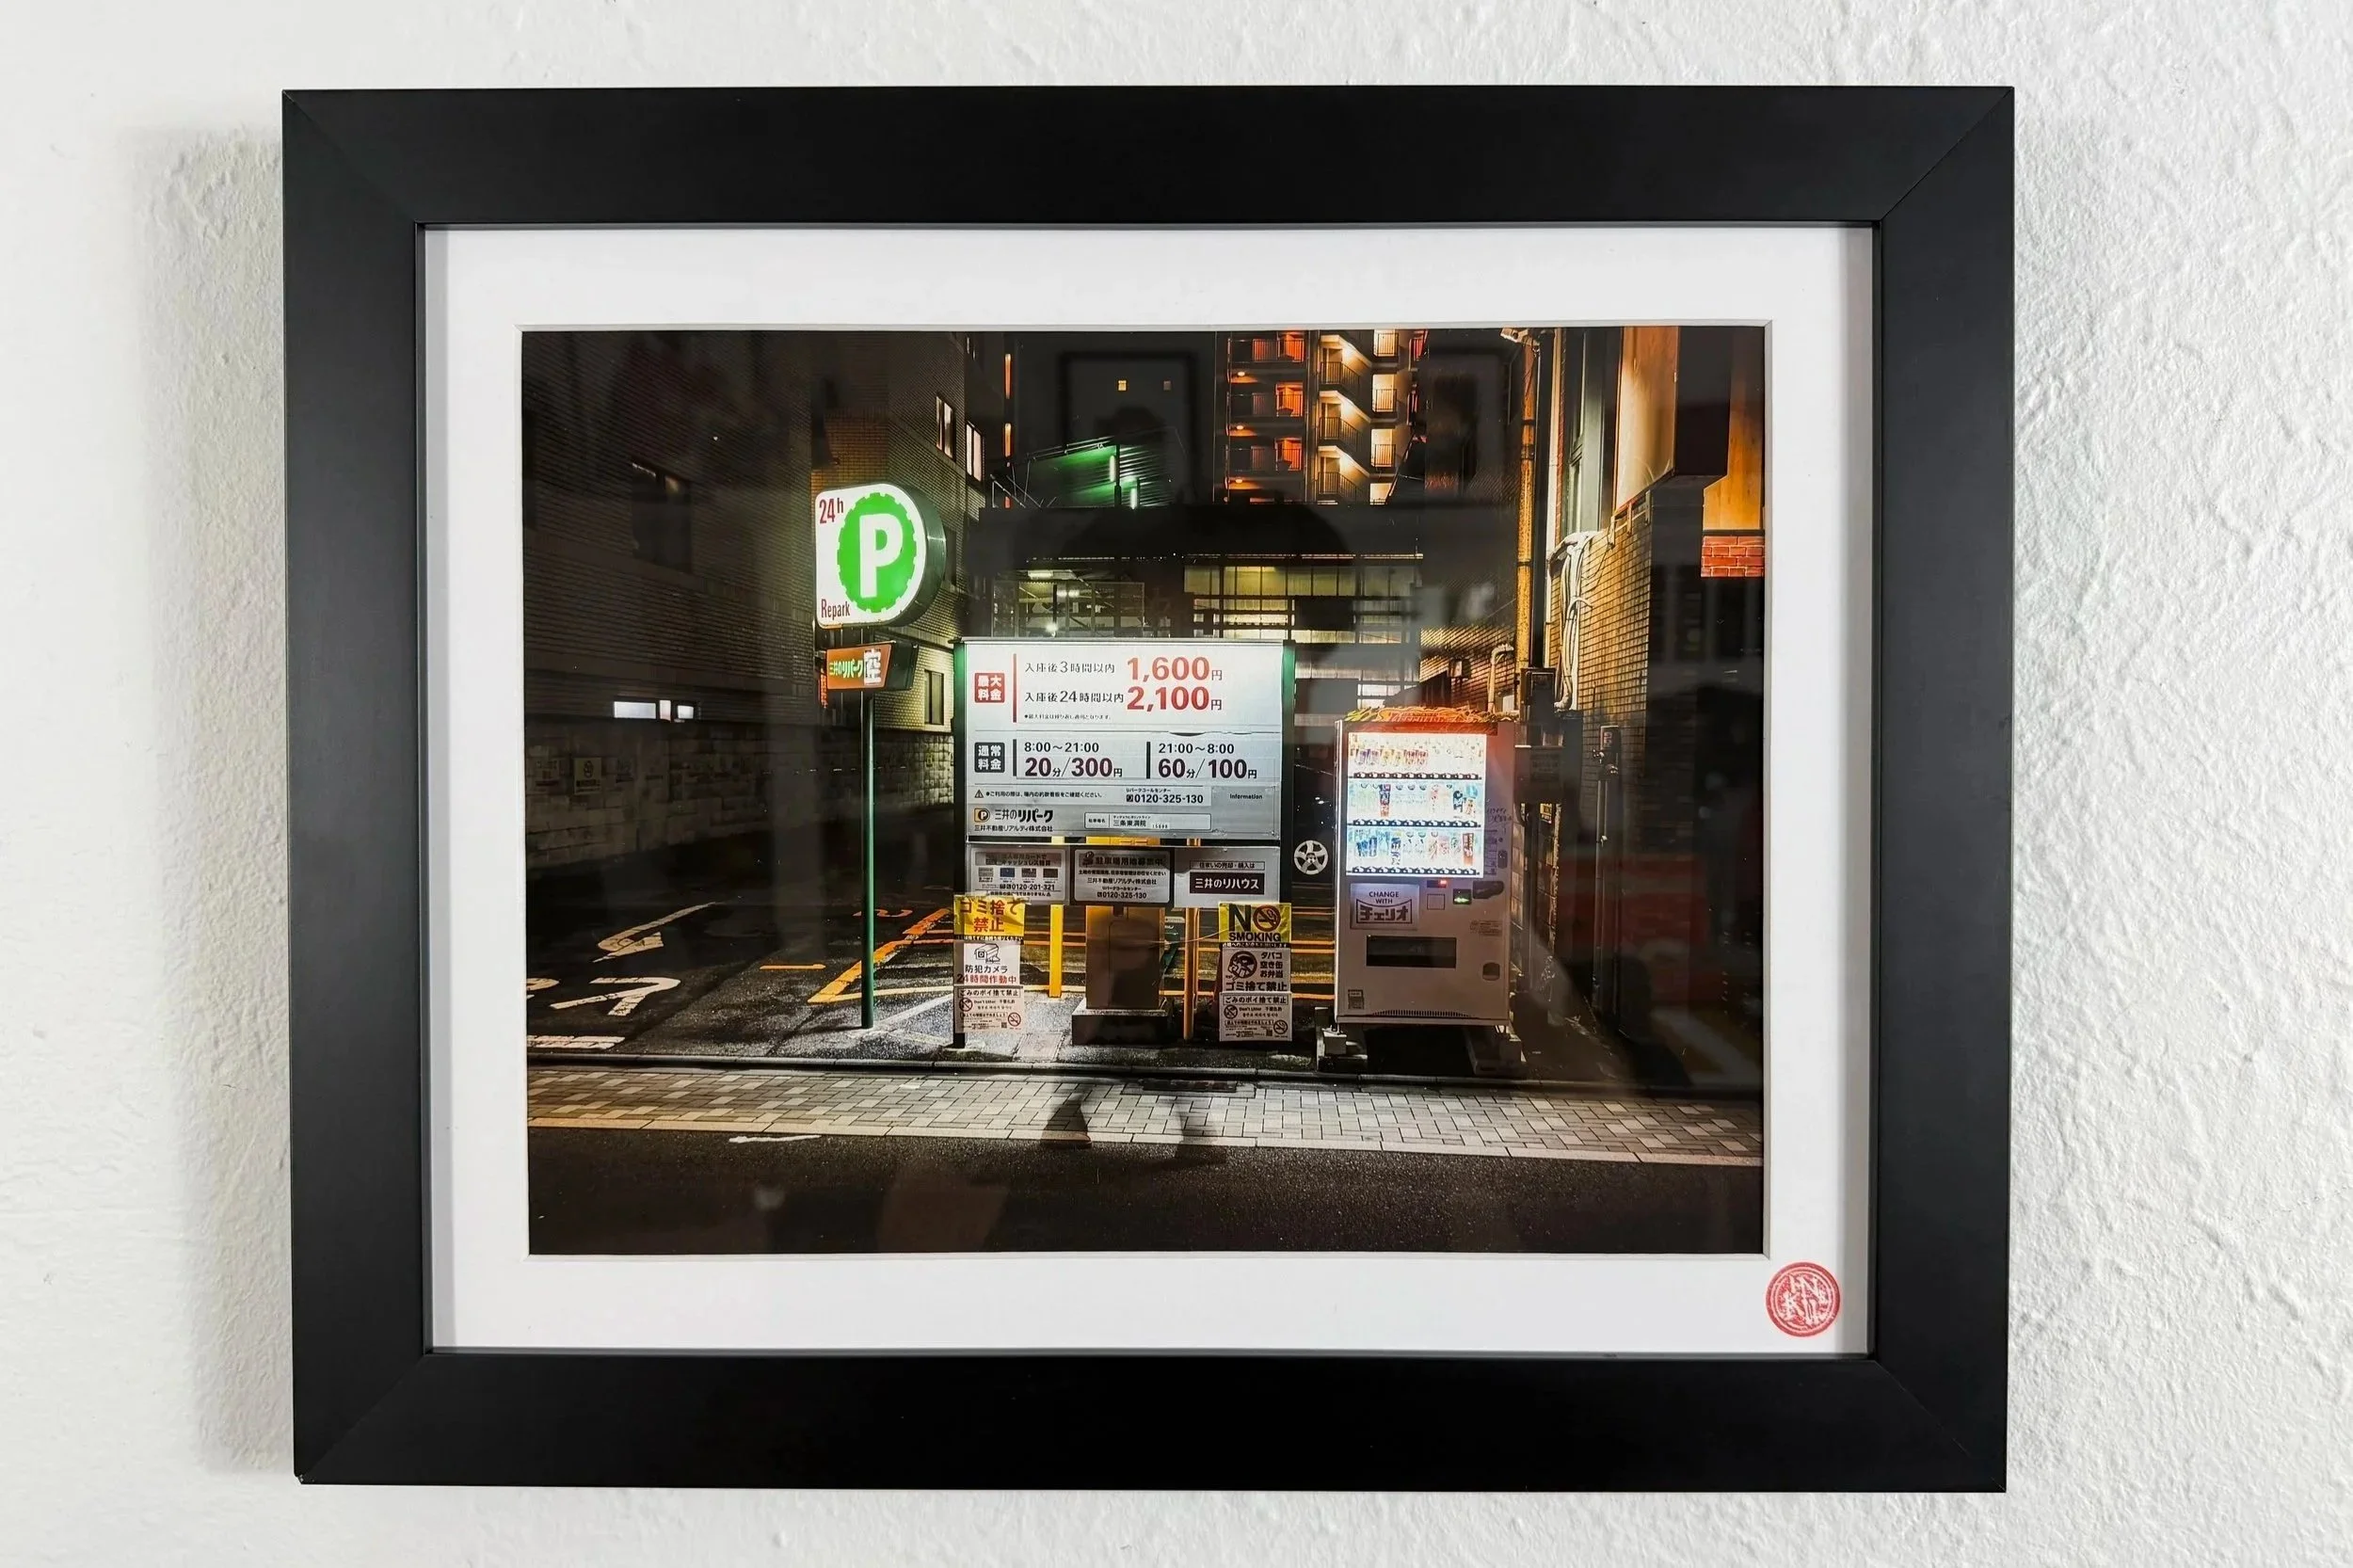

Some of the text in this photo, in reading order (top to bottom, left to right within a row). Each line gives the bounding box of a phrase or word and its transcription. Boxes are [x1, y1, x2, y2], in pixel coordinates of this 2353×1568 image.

[859, 513, 904, 599] P
[821, 599, 850, 620] Repark
[829, 659, 863, 679] 三井のリパーク
[978, 688, 1001, 700] 料金
[978, 744, 1001, 757] 通常
[978, 758, 1001, 770] 料金
[1134, 794, 1204, 804] 0120-325-130
[995, 808, 1053, 823] 三井のリパーク
[1194, 878, 1259, 889] 三井のリハウス
[960, 899, 1019, 916] ゴミ捨て
[1360, 905, 1409, 921] チェリオ
[973, 917, 1005, 933] 禁止
[1229, 932, 1281, 941] SMOKING
[1260, 952, 1282, 960] タバコ
[965, 964, 1008, 973] 防犯カメラ
[1260, 960, 1283, 969] 空き缶
[957, 973, 1016, 984] 24時間作動中
[1260, 969, 1284, 979] お弁当
[1225, 981, 1288, 991] ゴミ捨て禁止
